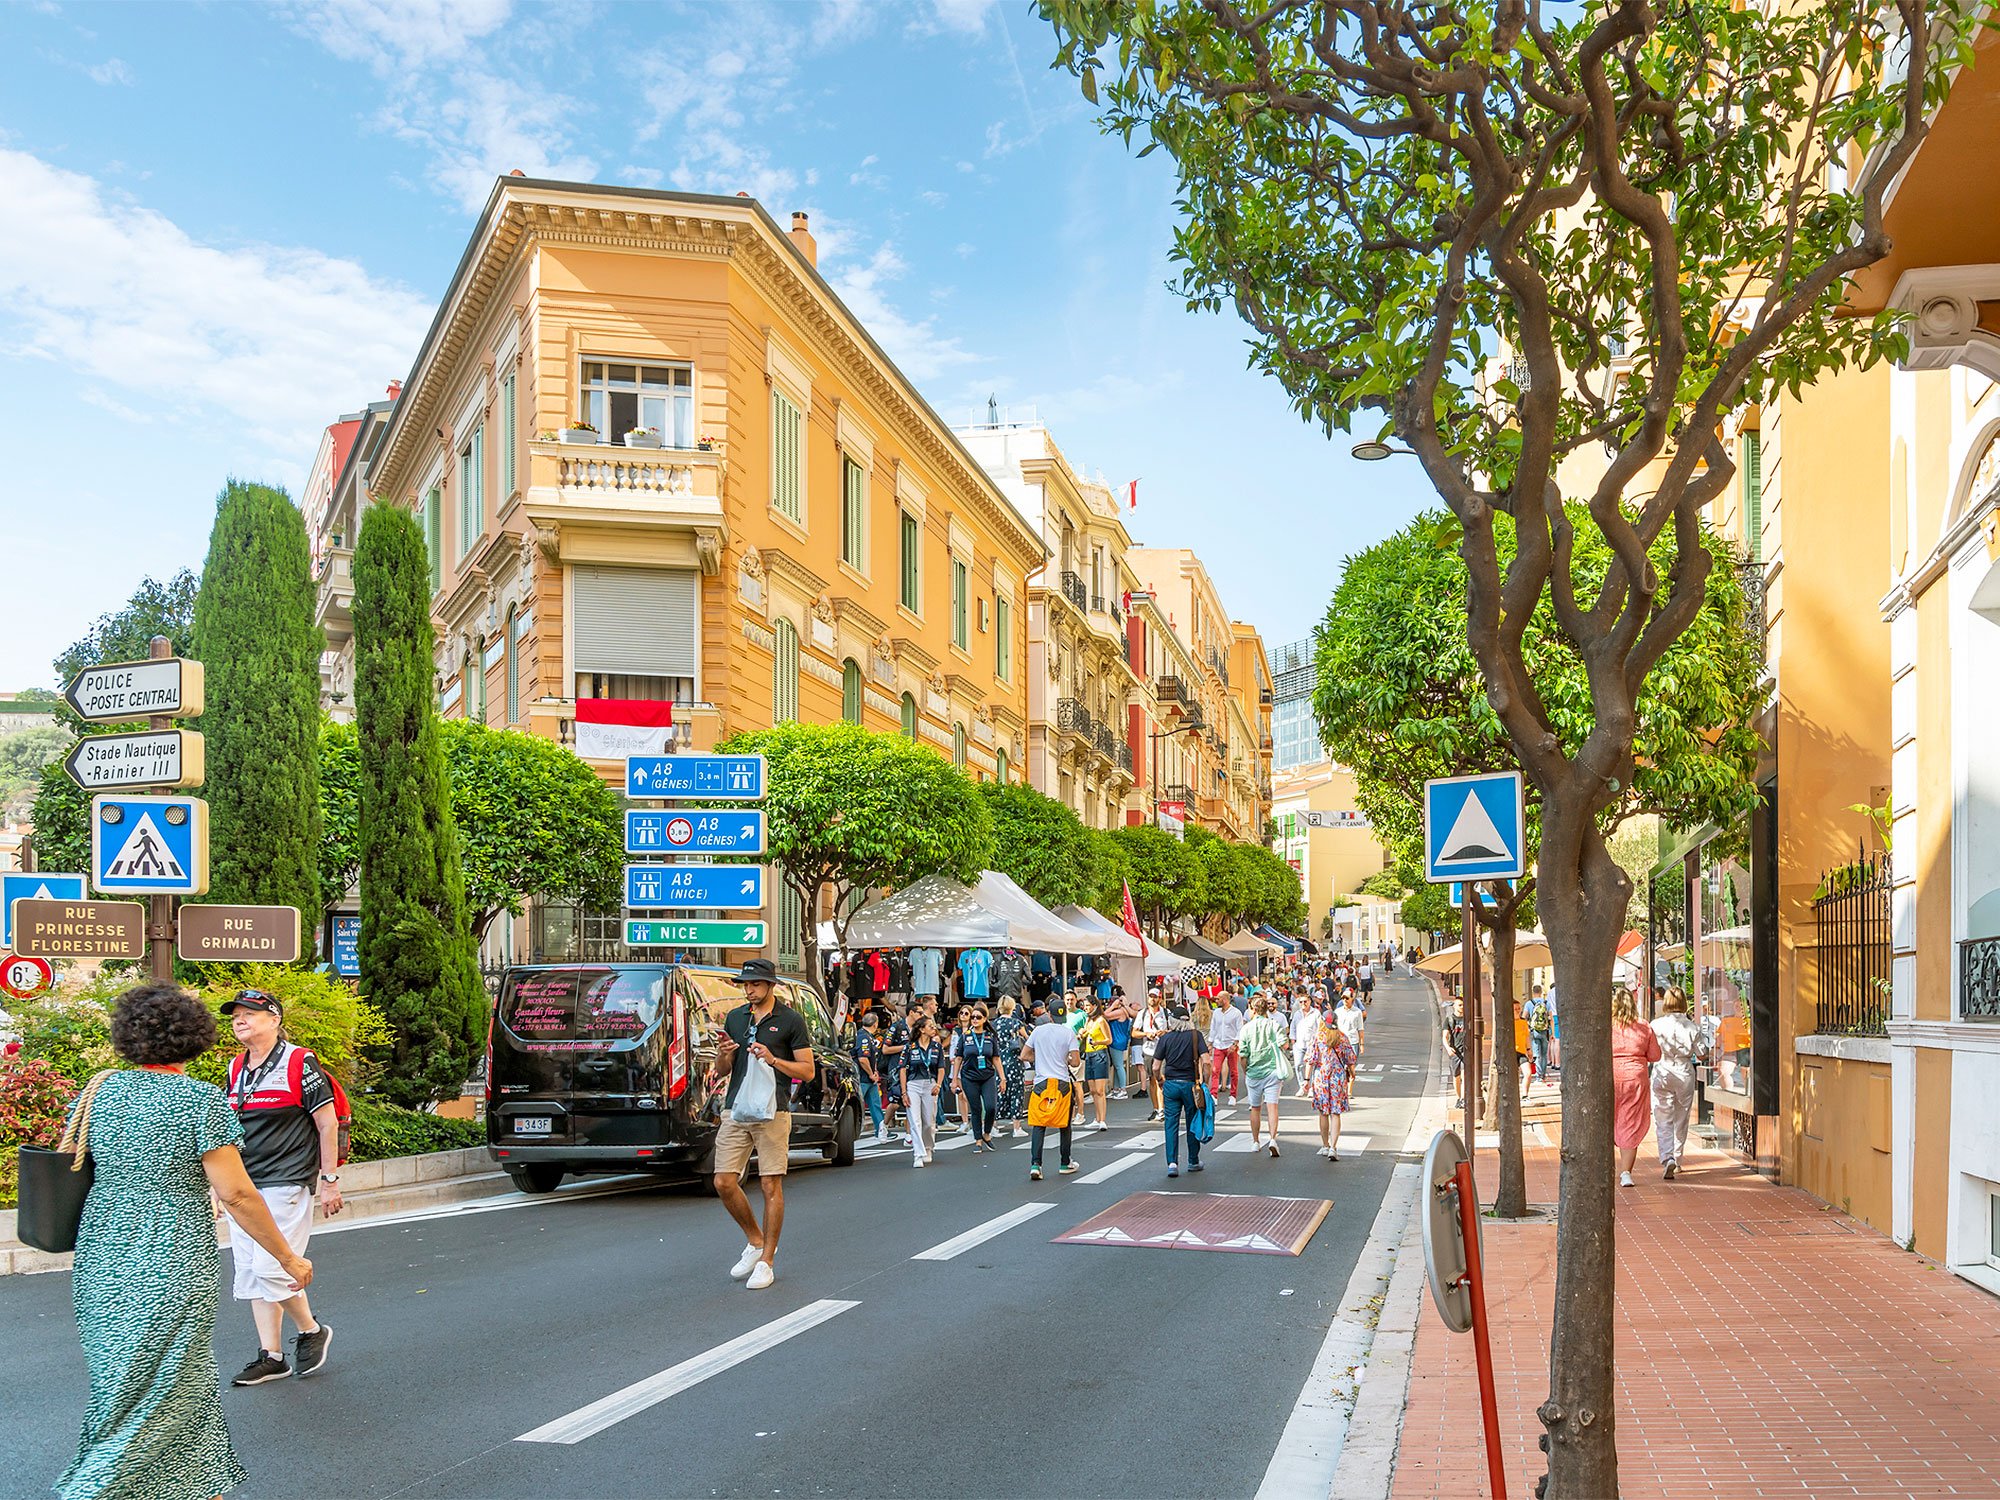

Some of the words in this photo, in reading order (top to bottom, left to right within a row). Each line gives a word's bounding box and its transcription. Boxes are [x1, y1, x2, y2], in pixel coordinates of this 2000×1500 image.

[86, 673, 133, 692] POLICE
[128, 687, 178, 707] CENTRAL
[580, 724, 600, 738] Go
[602, 734, 646, 750] Charles
[87, 743, 121, 762] Stade
[125, 741, 176, 760] Nautique
[152, 760, 170, 777] III
[652, 762, 673, 776] A8
[651, 777, 693, 790] (GÊNES)
[697, 818, 719, 831] A8
[696, 832, 737, 846] (GÊNES)
[671, 873, 693, 886] A8
[670, 888, 708, 900] (NICE)
[65, 907, 96, 920] RUE
[35, 923, 126, 937] PRINCESSE
[224, 918, 254, 931] RUE
[337, 929, 351, 937] Saint
[660, 927, 698, 940] NICE
[31, 939, 130, 953] FLORESTINE
[201, 936, 277, 950] GRIMALDI
[515, 1007, 544, 1019] Gastaldi
[544, 1006, 565, 1017] fleurs
[525, 1119, 549, 1130] 343F
